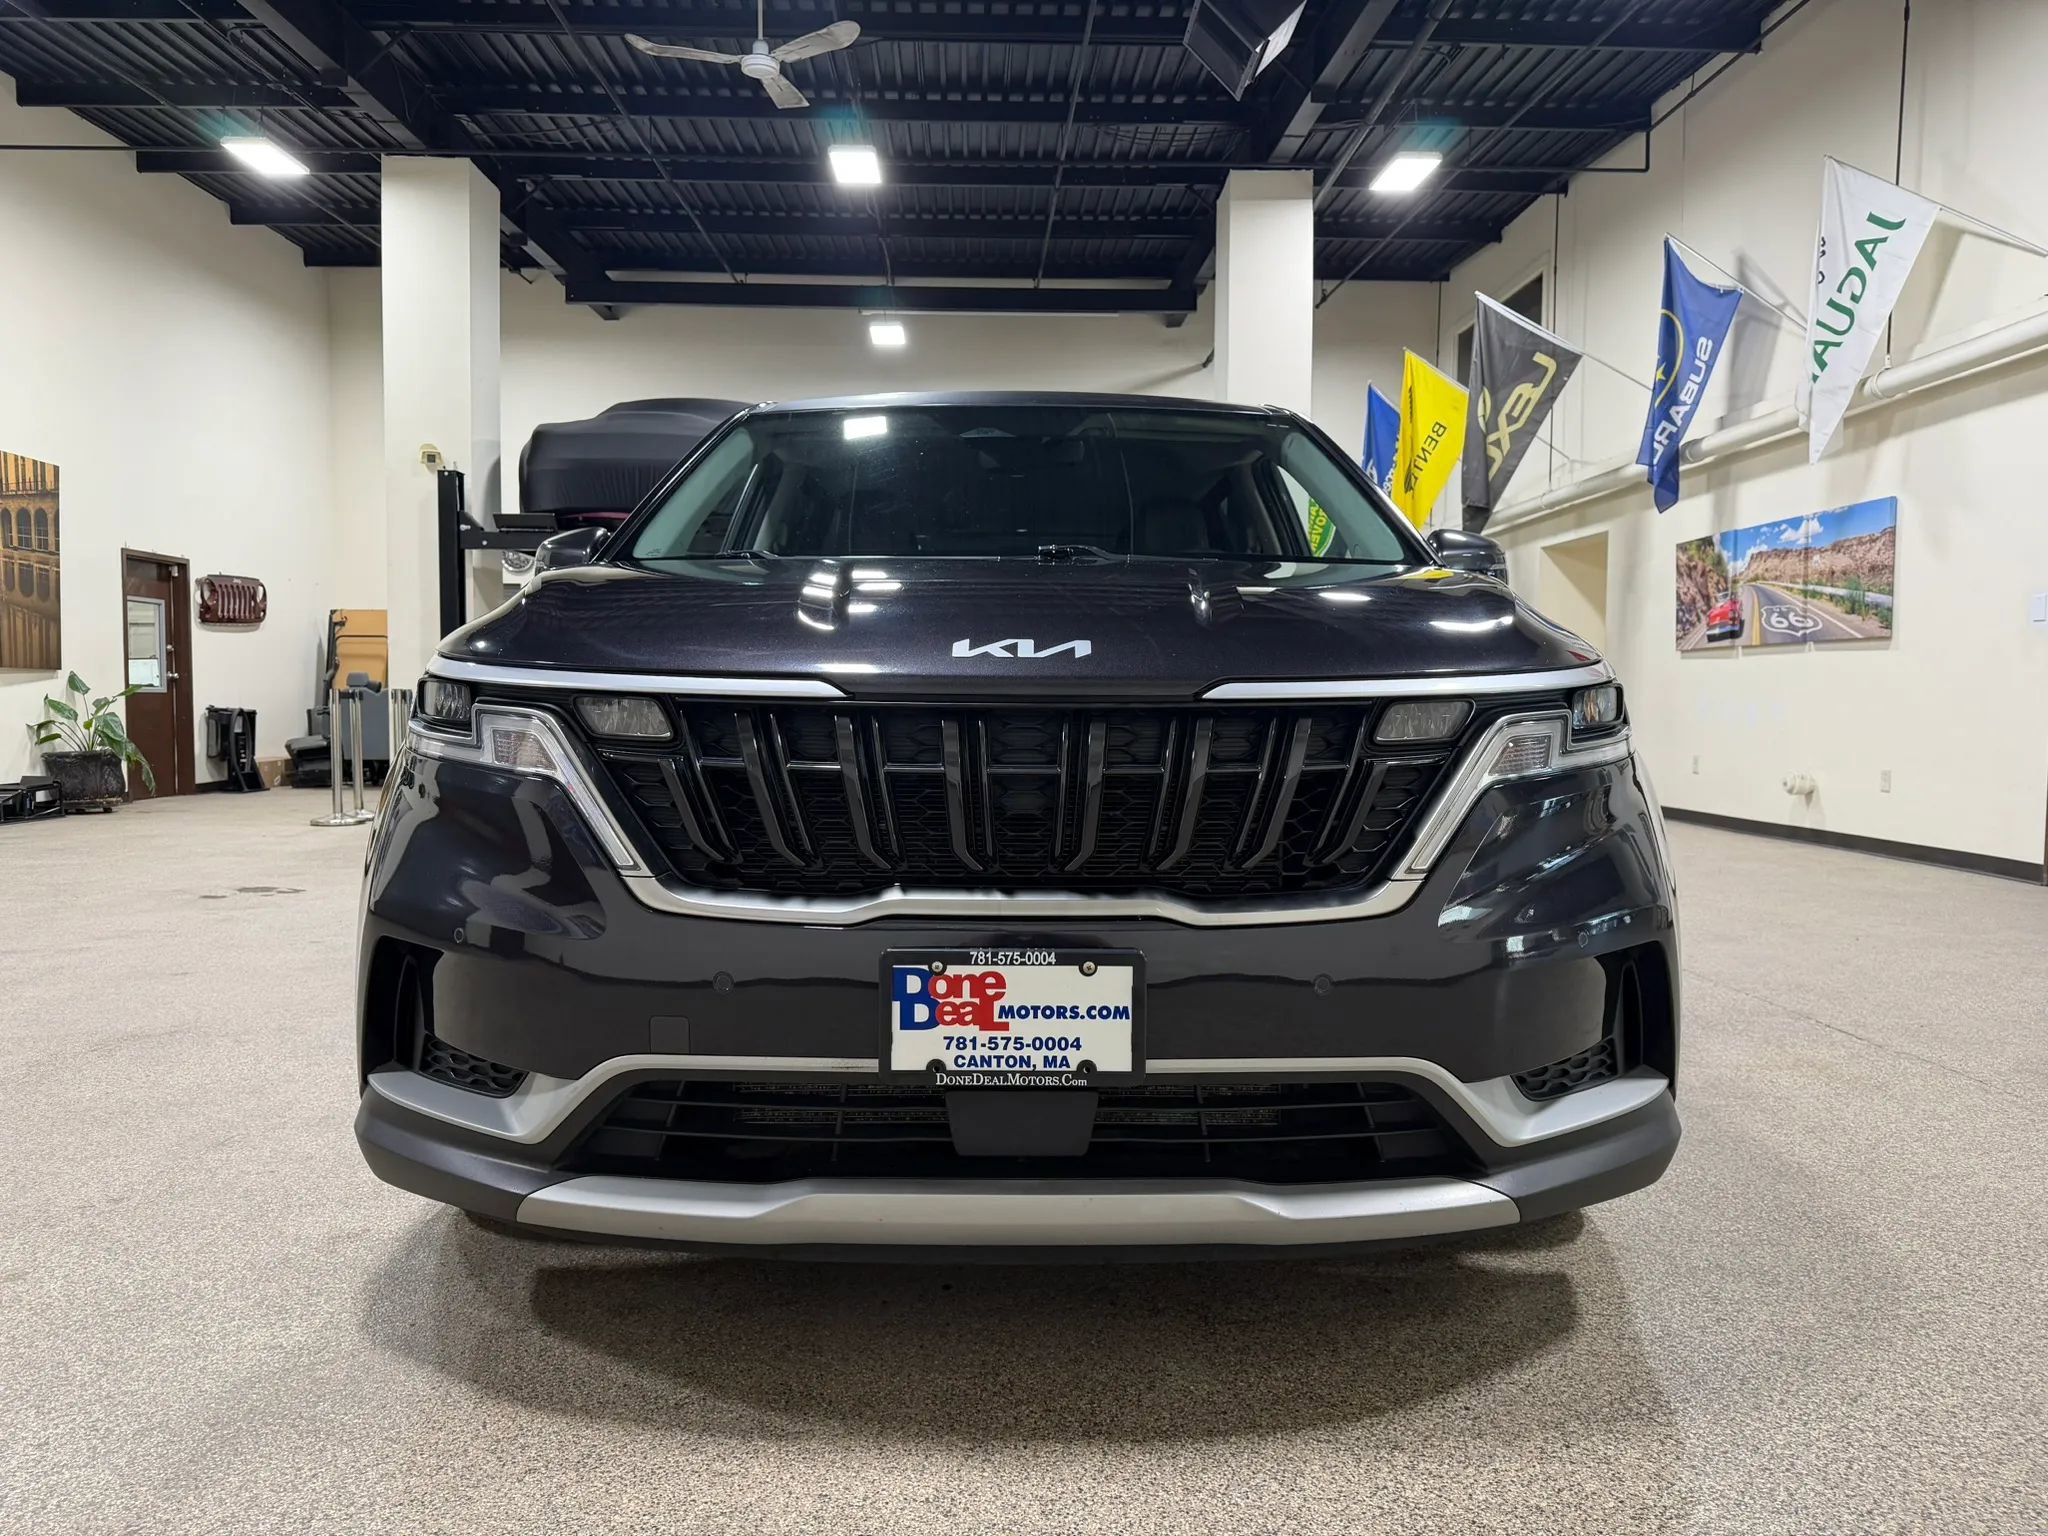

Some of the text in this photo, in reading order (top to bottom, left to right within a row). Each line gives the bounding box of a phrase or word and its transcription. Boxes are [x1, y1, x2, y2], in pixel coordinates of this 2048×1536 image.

[1771, 612, 1814, 628] 66
[952, 638, 1092, 659] KIA
[969, 951, 1057, 965] 781-575-0004
[892, 967, 1007, 1002] Done
[997, 1005, 1131, 1020] MOTORS.COM
[942, 1036, 1082, 1051] 781-575-0004
[953, 1054, 1071, 1071] CANTON, MA
